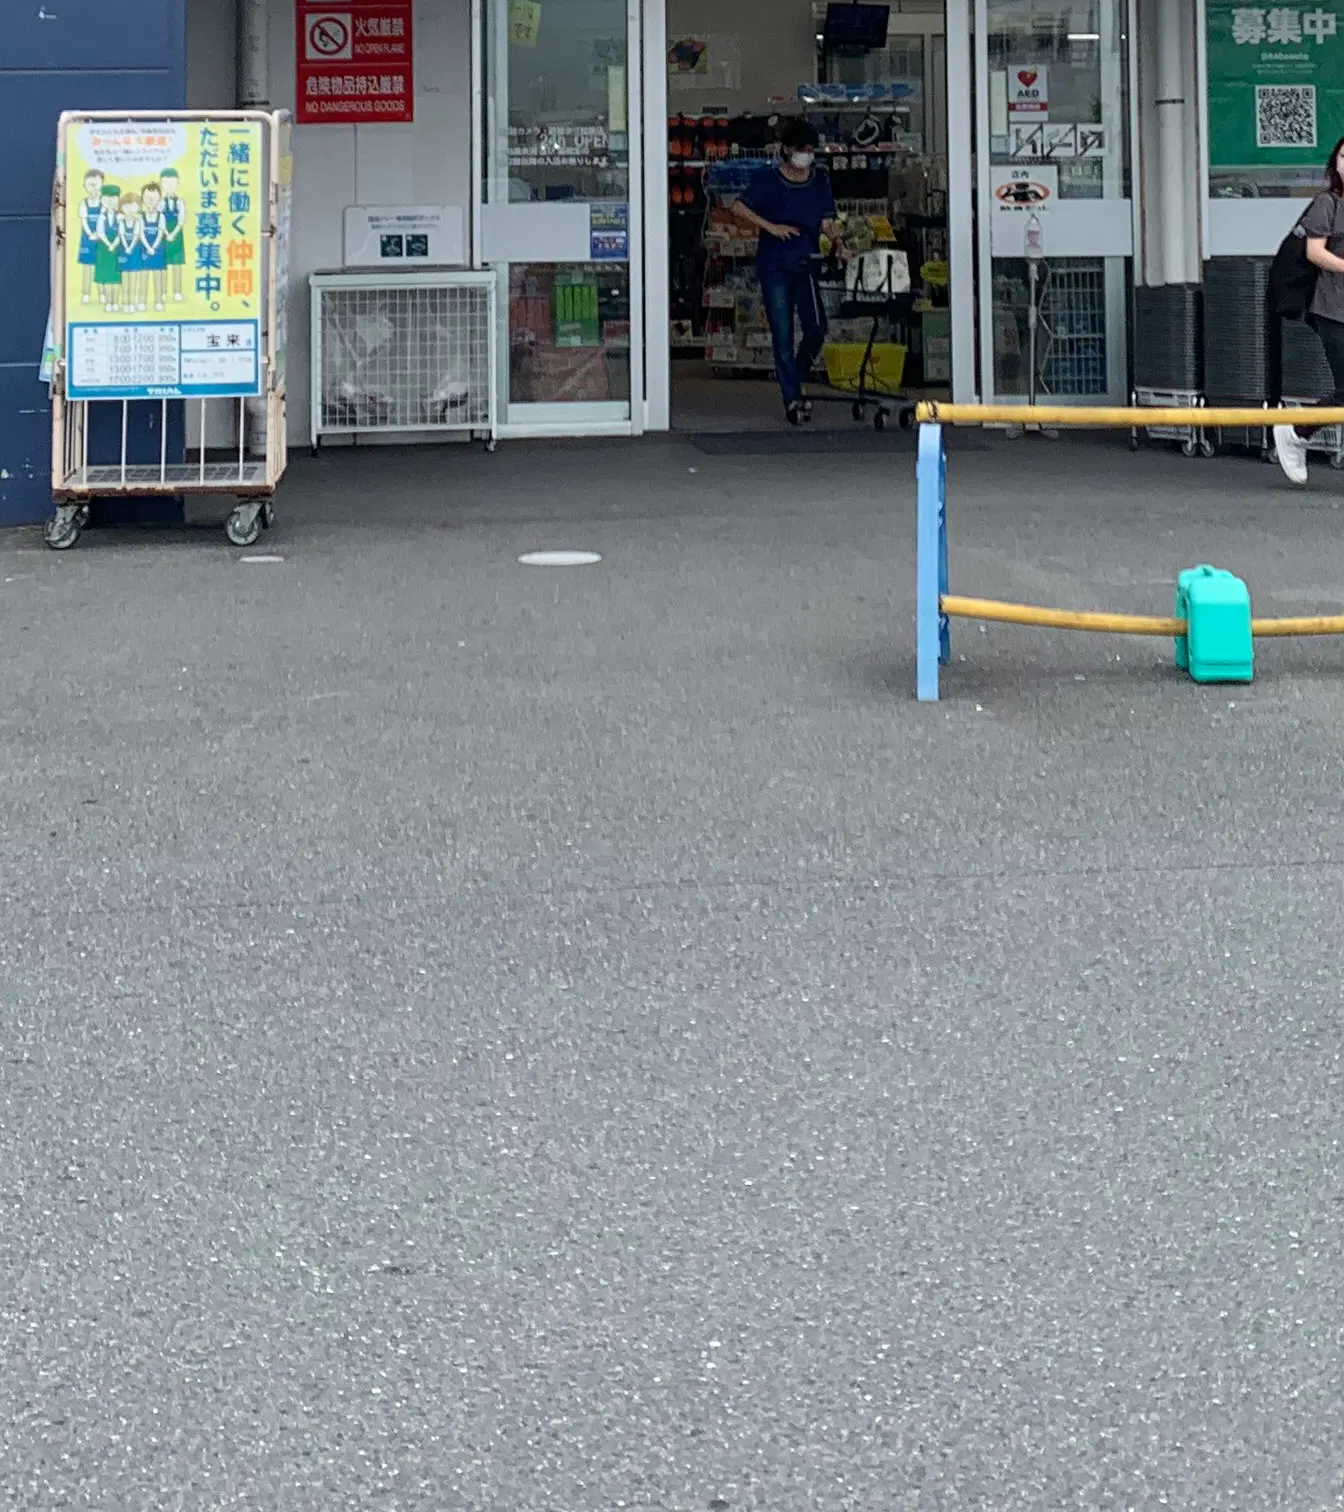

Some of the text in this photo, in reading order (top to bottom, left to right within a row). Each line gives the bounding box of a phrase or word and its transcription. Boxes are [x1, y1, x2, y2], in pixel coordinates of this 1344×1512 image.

[1230, 7, 1337, 45] 募集中
[306, 101, 318, 113] NO
[195, 127, 222, 312] ただいま募集中。
[226, 128, 253, 308] 一緒に働く仲間、
